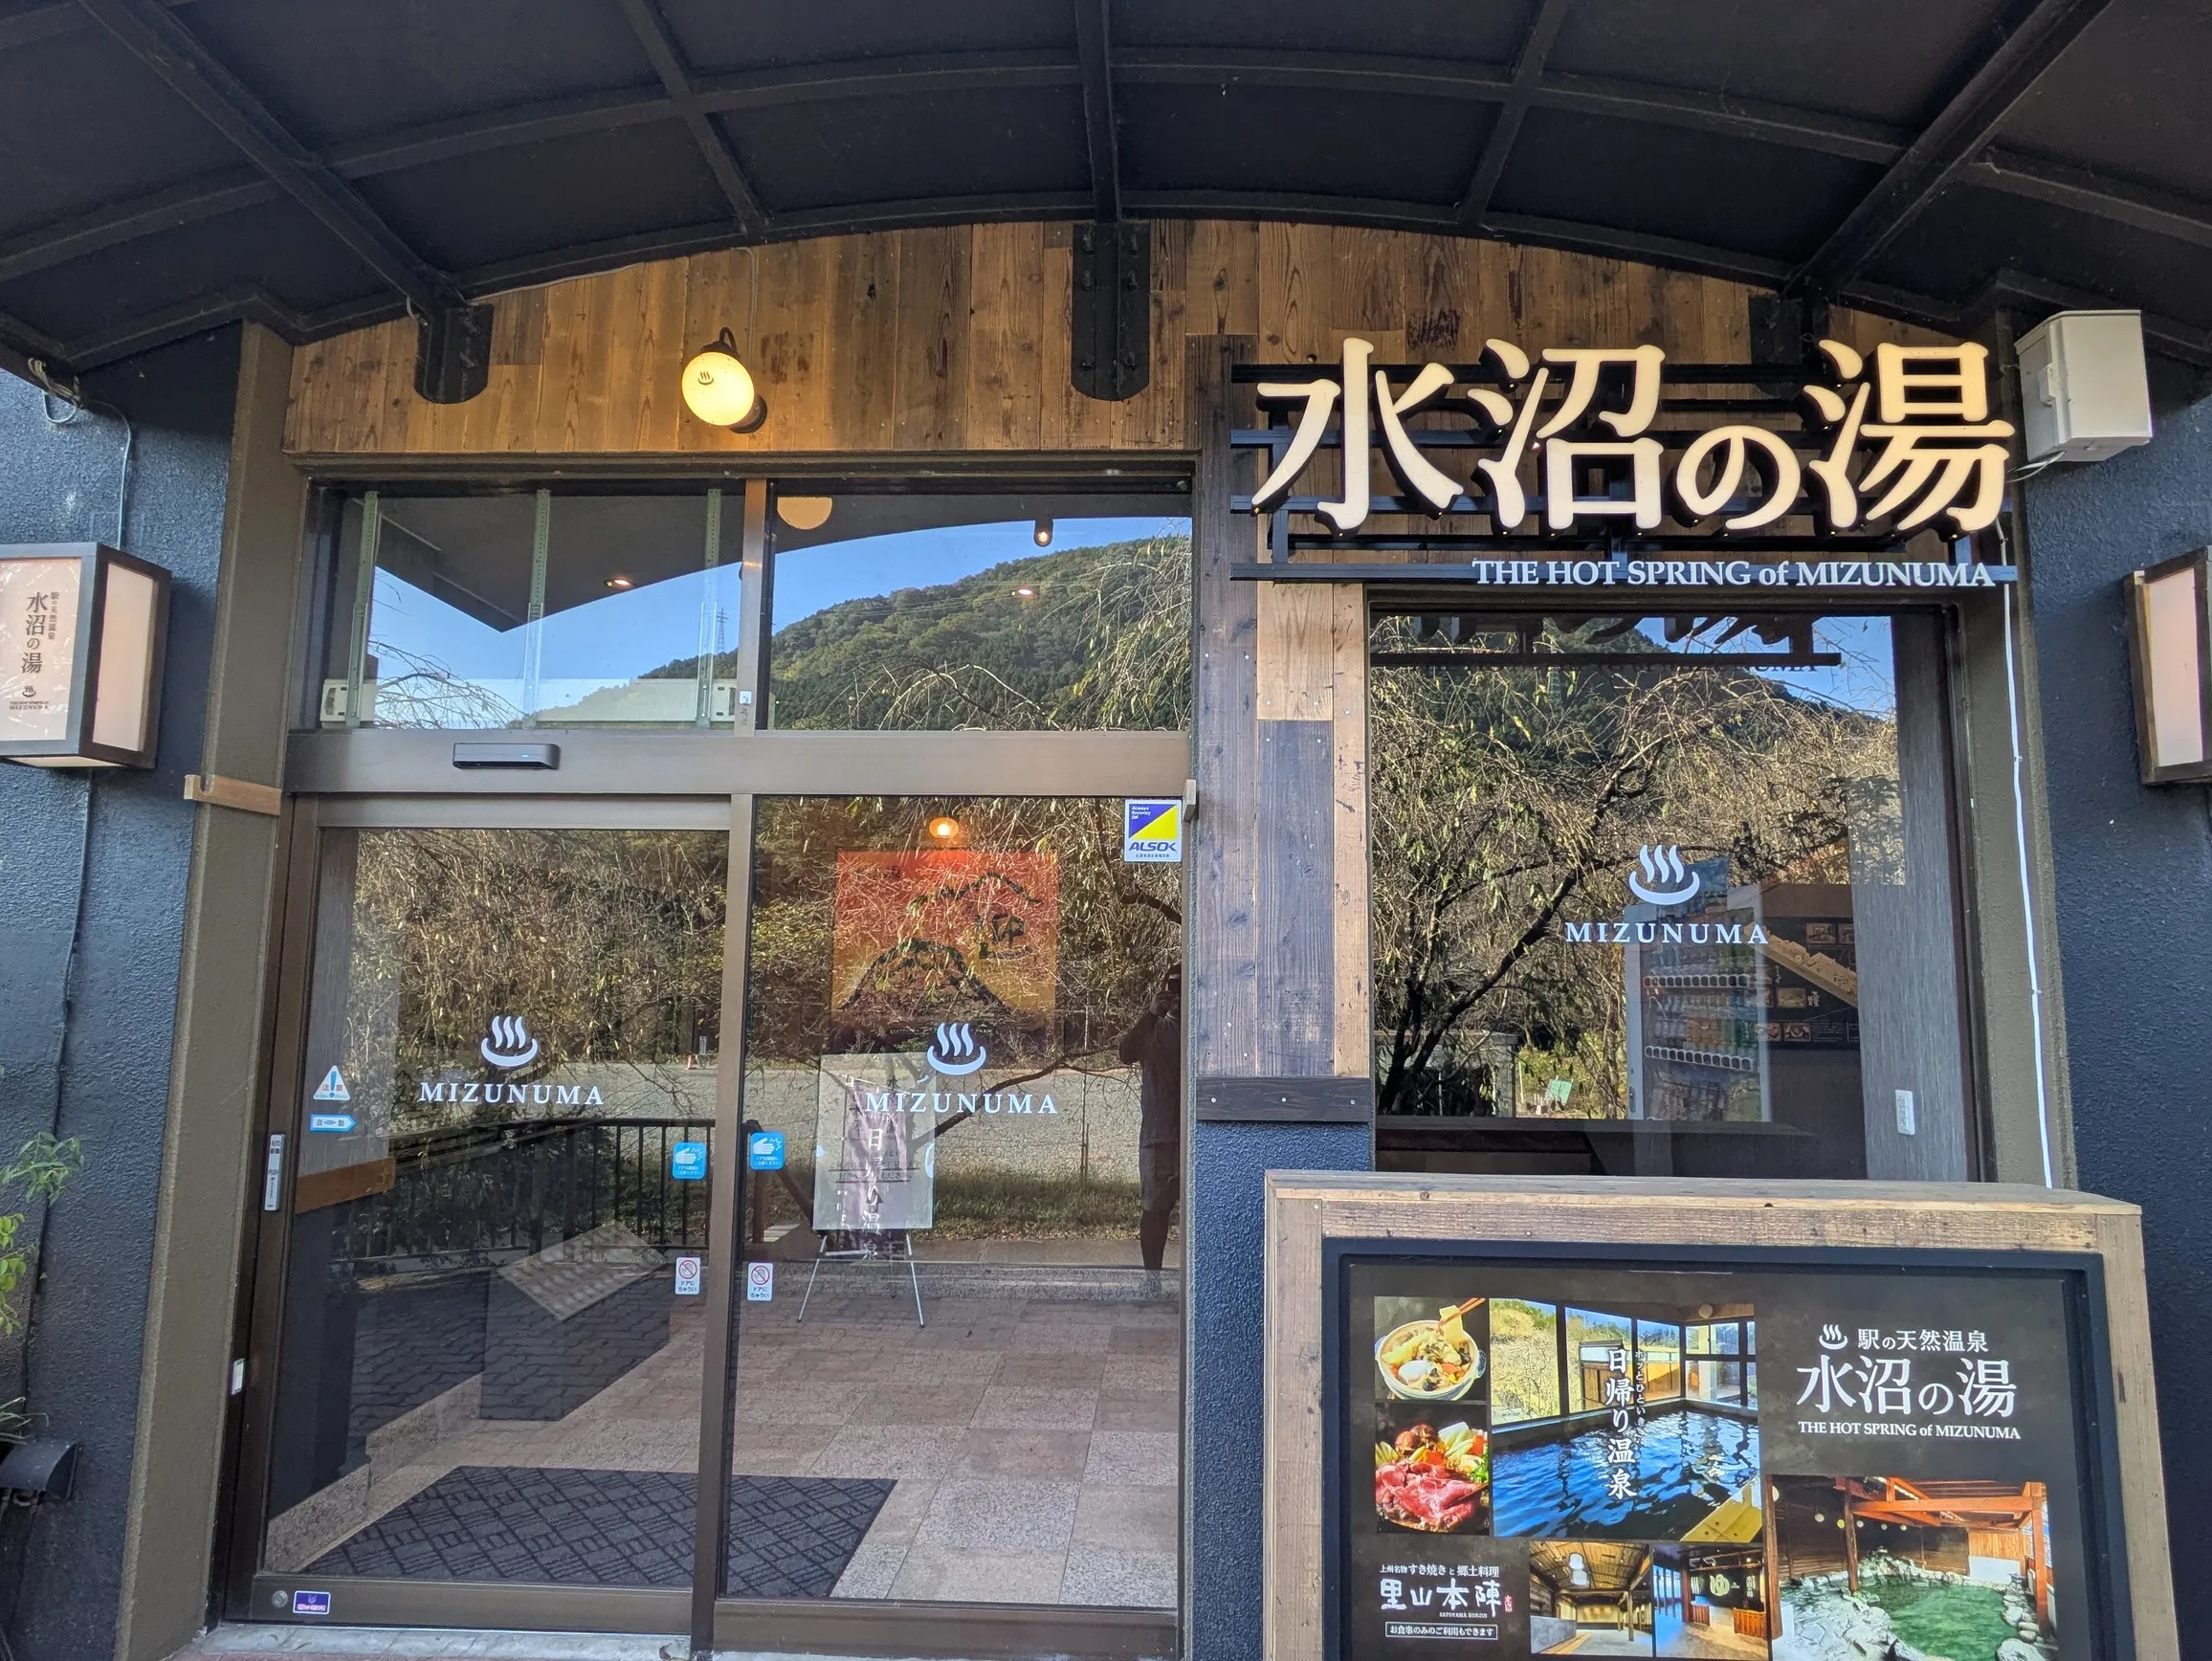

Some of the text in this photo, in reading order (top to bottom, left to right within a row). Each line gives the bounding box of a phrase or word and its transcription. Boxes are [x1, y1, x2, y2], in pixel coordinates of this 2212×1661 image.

[1251, 337, 2017, 532] 水沼の湯
[1471, 560, 1997, 587] THE HOT SPRING of MIZUNUMA
[21, 591, 49, 674] 水沼の湯
[1129, 842, 1177, 853] ALSOK
[1565, 922, 1768, 944] MIZUNUMA
[418, 1082, 604, 1105] MIZUNUMA
[866, 1093, 1057, 1115] MIZUNUMA
[1857, 1328, 1989, 1353] 駅の天然温泉
[1796, 1354, 2018, 1418] 水沼の湯
[1605, 1348, 1638, 1500] 日帰り温泉
[1798, 1421, 2022, 1440] THE HOT SPRING of MIZUNUMA
[1709, 1573, 1730, 1597] ゆ
[1380, 1578, 1501, 1618] 里山本陣
[1389, 1625, 1493, 1637] お食事のみのご利用もできます
